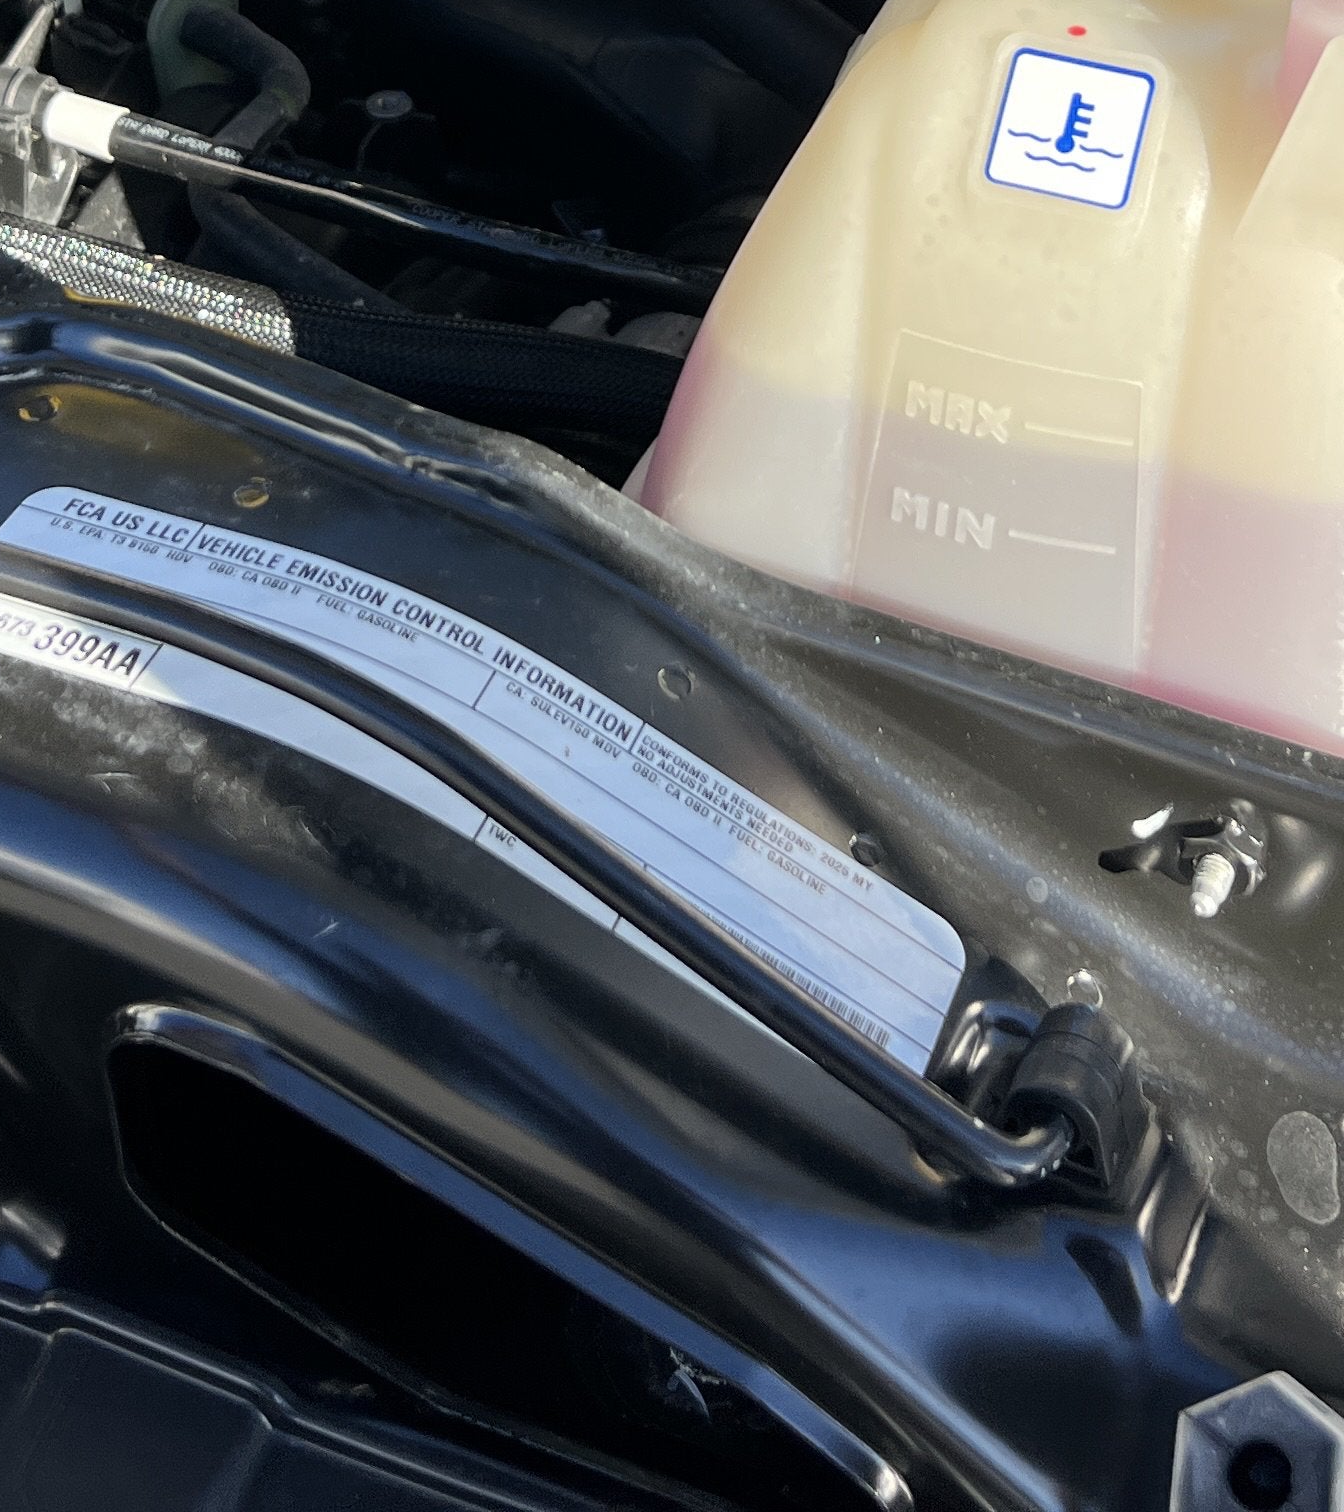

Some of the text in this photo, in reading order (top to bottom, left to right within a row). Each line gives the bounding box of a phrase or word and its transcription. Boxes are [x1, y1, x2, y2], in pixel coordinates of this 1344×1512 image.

[904, 378, 1012, 445] MAX
[890, 485, 996, 551] MIN
[50, 517, 74, 532] U.S.
[207, 561, 238, 577] OBD:
[241, 569, 259, 583] CA
[262, 576, 289, 592] OBD
[316, 593, 355, 615] FUEL:
[357, 608, 419, 644] GASOLINE
[64, 498, 634, 743] FCA US LLC VEHICLE EMISSION CONTROL INFORMATION
[33, 623, 143, 677] 399AA
[487, 822, 519, 849] TWC
[505, 680, 528, 698] CA:
[592, 736, 622, 759] MDV
[631, 761, 662, 787] OBD:
[664, 784, 683, 801] CA
[683, 795, 713, 819] OBD
[713, 815, 724, 827] II
[727, 824, 766, 854] FUEL:
[766, 847, 829, 897] GASOLINE
[637, 744, 795, 854] NO ADJUSTMENTS NEEDED
[641, 734, 711, 785] CONFORMS
[712, 776, 730, 795] TO
[729, 788, 817, 860] REGULATIONS:
[852, 871, 875, 893] MY
